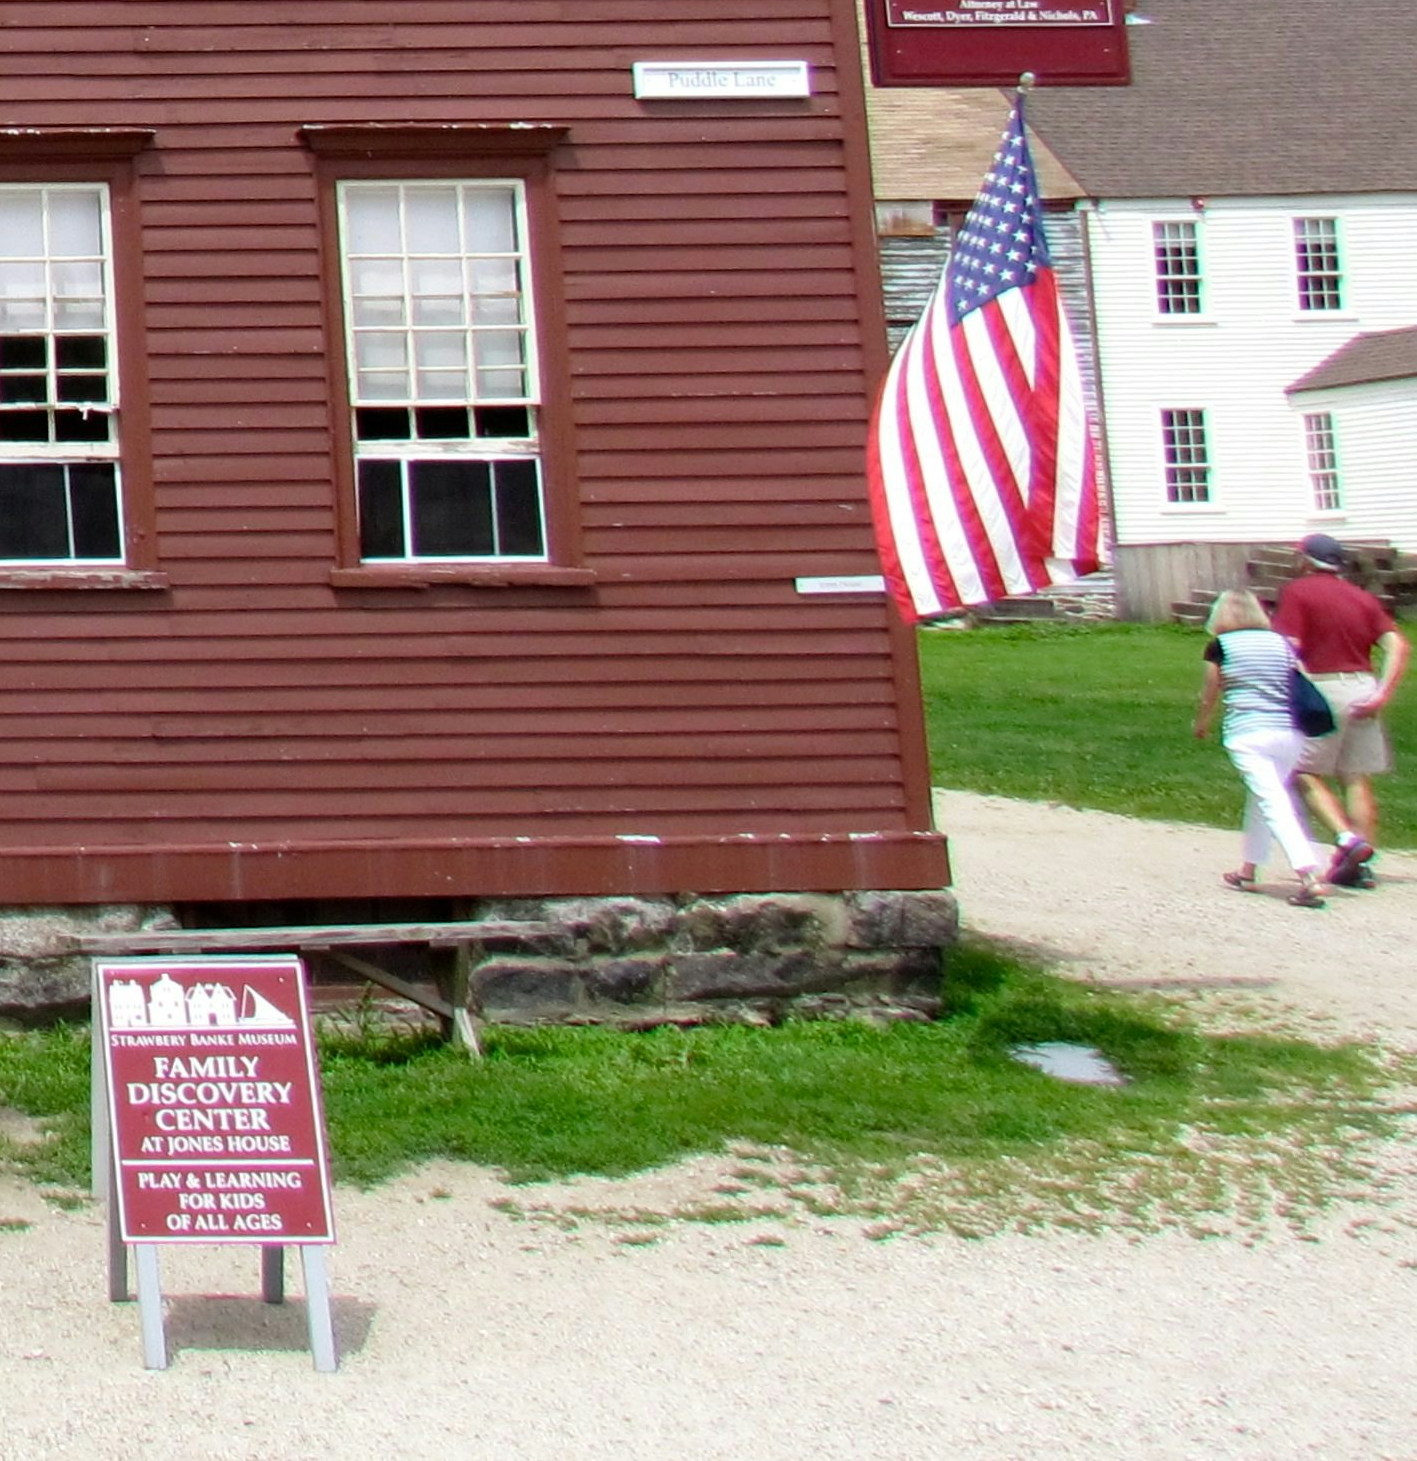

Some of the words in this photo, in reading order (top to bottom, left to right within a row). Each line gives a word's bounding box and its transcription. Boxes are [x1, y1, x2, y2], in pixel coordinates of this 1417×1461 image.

[960, 0, 1003, 10] Attorney
[1006, 0, 1016, 8] at
[1018, 0, 1038, 8] Law
[946, 12, 973, 23] Dyer,
[976, 11, 1024, 22] Fitzgerald
[1027, 11, 1037, 20] &
[1082, 10, 1098, 20] PA
[668, 72, 728, 88] Puddle
[734, 71, 776, 87] Lane
[111, 1034, 187, 1047] STRAWBERY
[191, 1033, 234, 1046] BANKE
[238, 1033, 297, 1045] MUSEUM
[153, 1056, 259, 1078] FAMILY
[127, 1082, 292, 1104] DISCOVERY
[155, 1108, 270, 1130] CENTER
[141, 1136, 163, 1152] AT
[166, 1136, 223, 1155] JONES
[227, 1136, 291, 1151] HOUSE
[138, 1173, 182, 1188] PLAY
[186, 1173, 201, 1188] &
[205, 1172, 302, 1188] LEARNING
[179, 1193, 215, 1209] FOR
[220, 1193, 265, 1209] KIDS
[166, 1214, 192, 1230] OF
[194, 1214, 230, 1230] ALL
[233, 1214, 282, 1230] AGES
